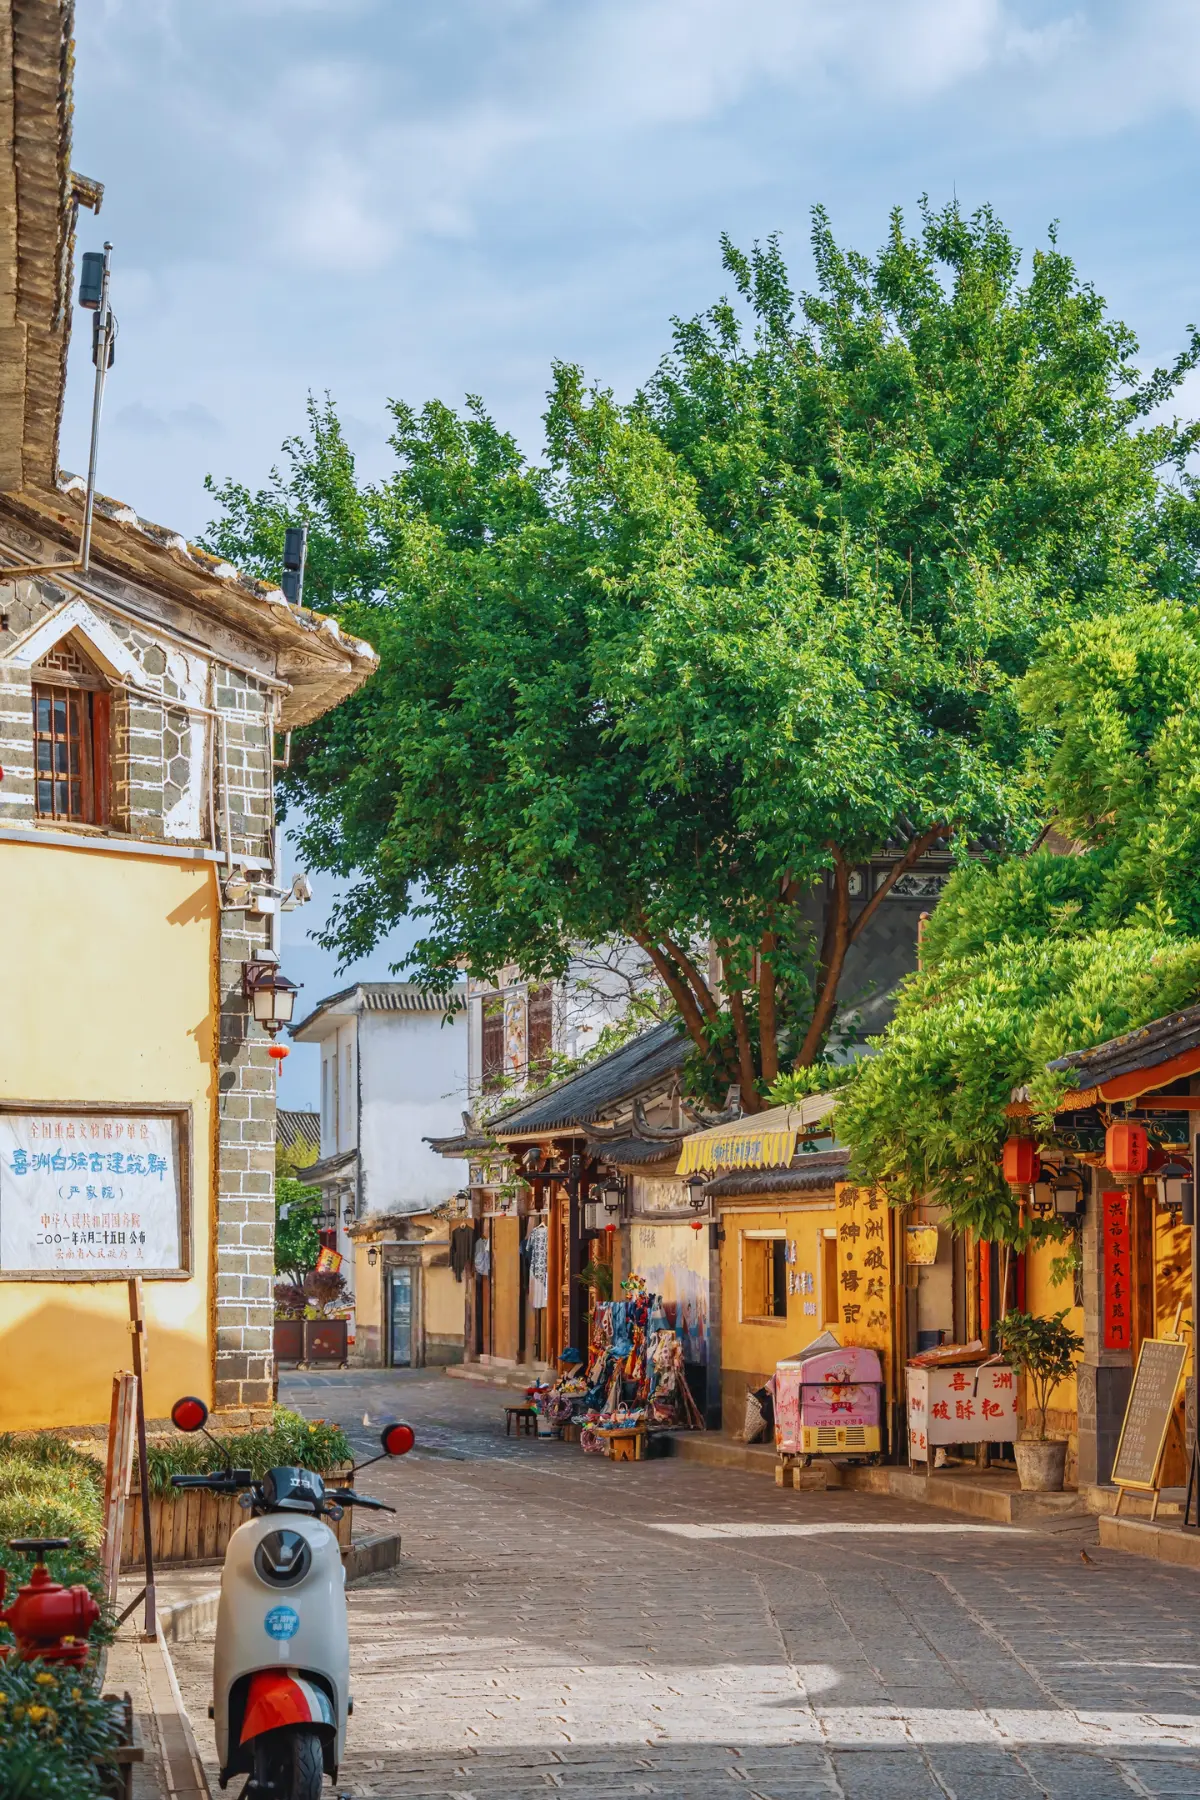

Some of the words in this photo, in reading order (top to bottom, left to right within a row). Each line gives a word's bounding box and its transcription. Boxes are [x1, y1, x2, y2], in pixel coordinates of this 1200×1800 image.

[30, 1121, 150, 1139] 全国重点文物保护单位
[9, 1147, 168, 1181] 喜洲白族古建筑群
[40, 1212, 141, 1229] 中华人民共和国国务院
[55, 1246, 128, 1260] 云南省人民政府
